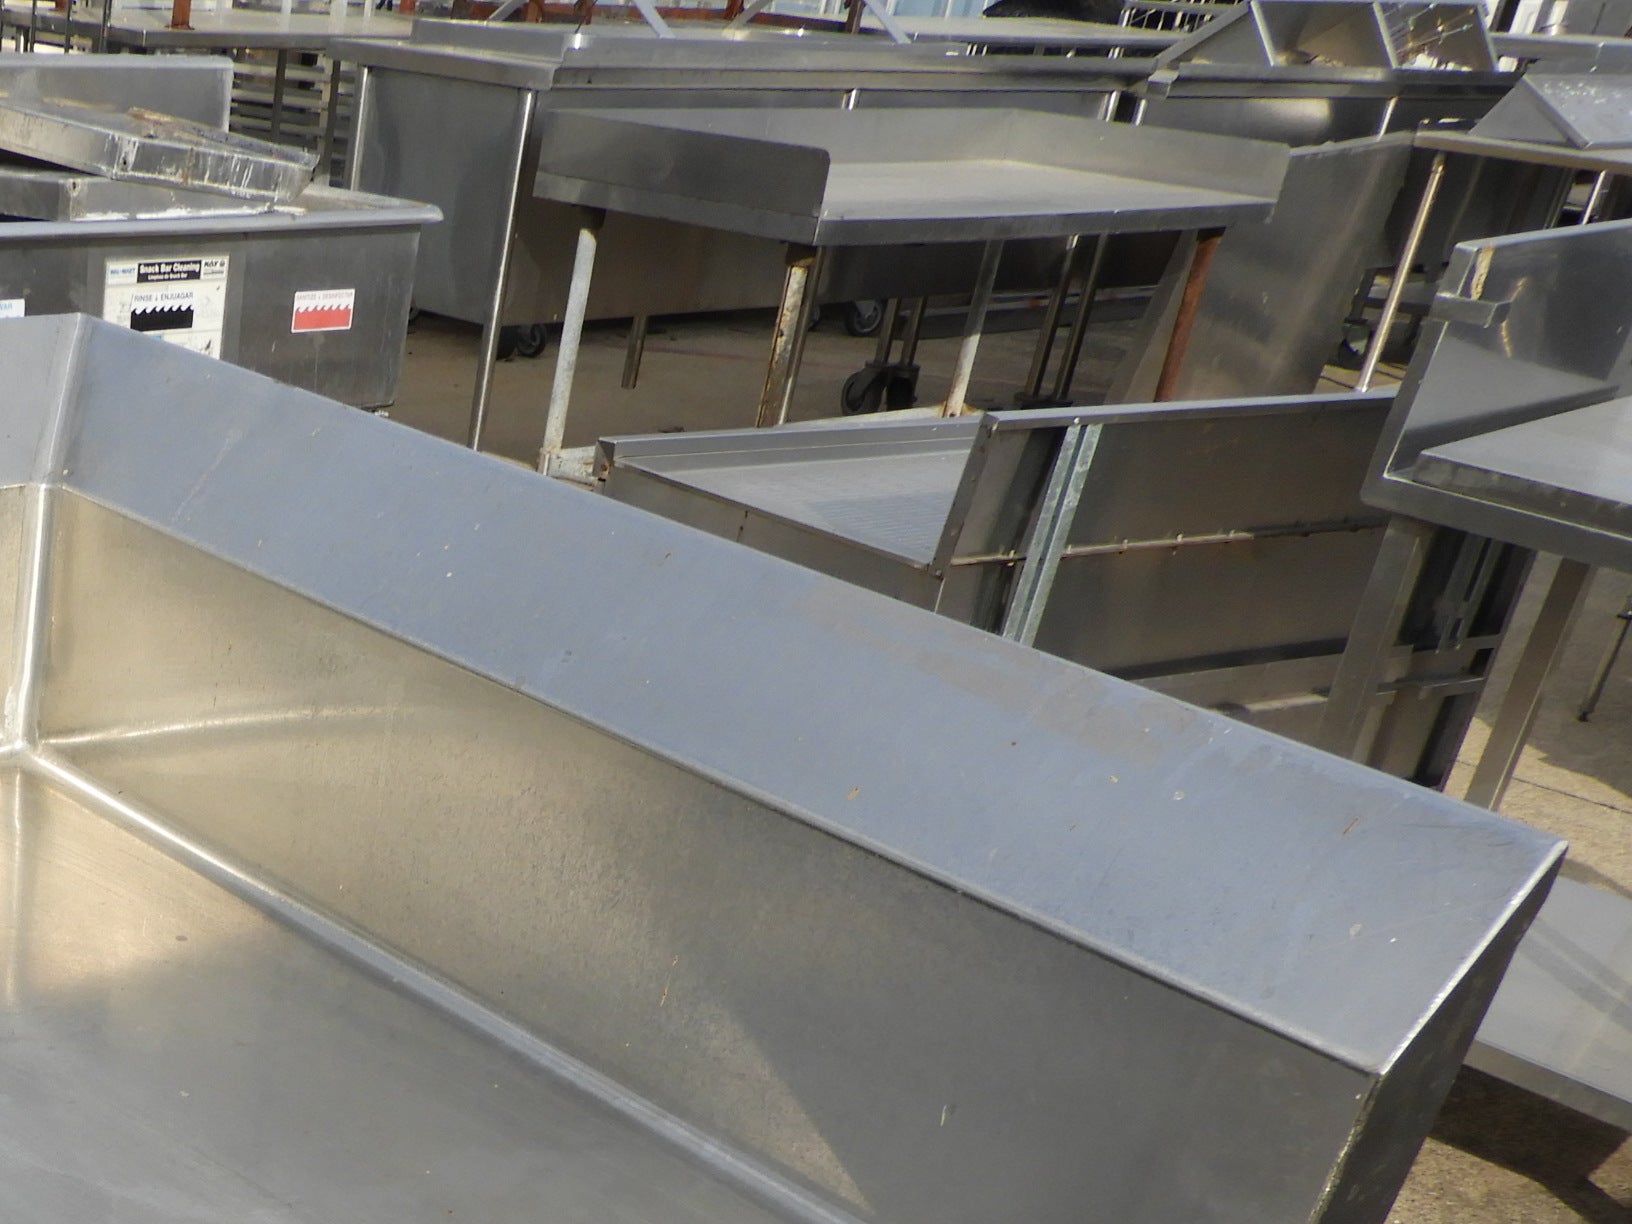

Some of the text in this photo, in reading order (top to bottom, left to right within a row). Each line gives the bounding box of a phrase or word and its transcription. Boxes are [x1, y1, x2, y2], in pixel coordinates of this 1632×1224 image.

[140, 264, 159, 274] Snack
[161, 263, 173, 273] Bar
[173, 262, 200, 273] Cleaning
[134, 292, 193, 302] RINSE ENJUAGAR
